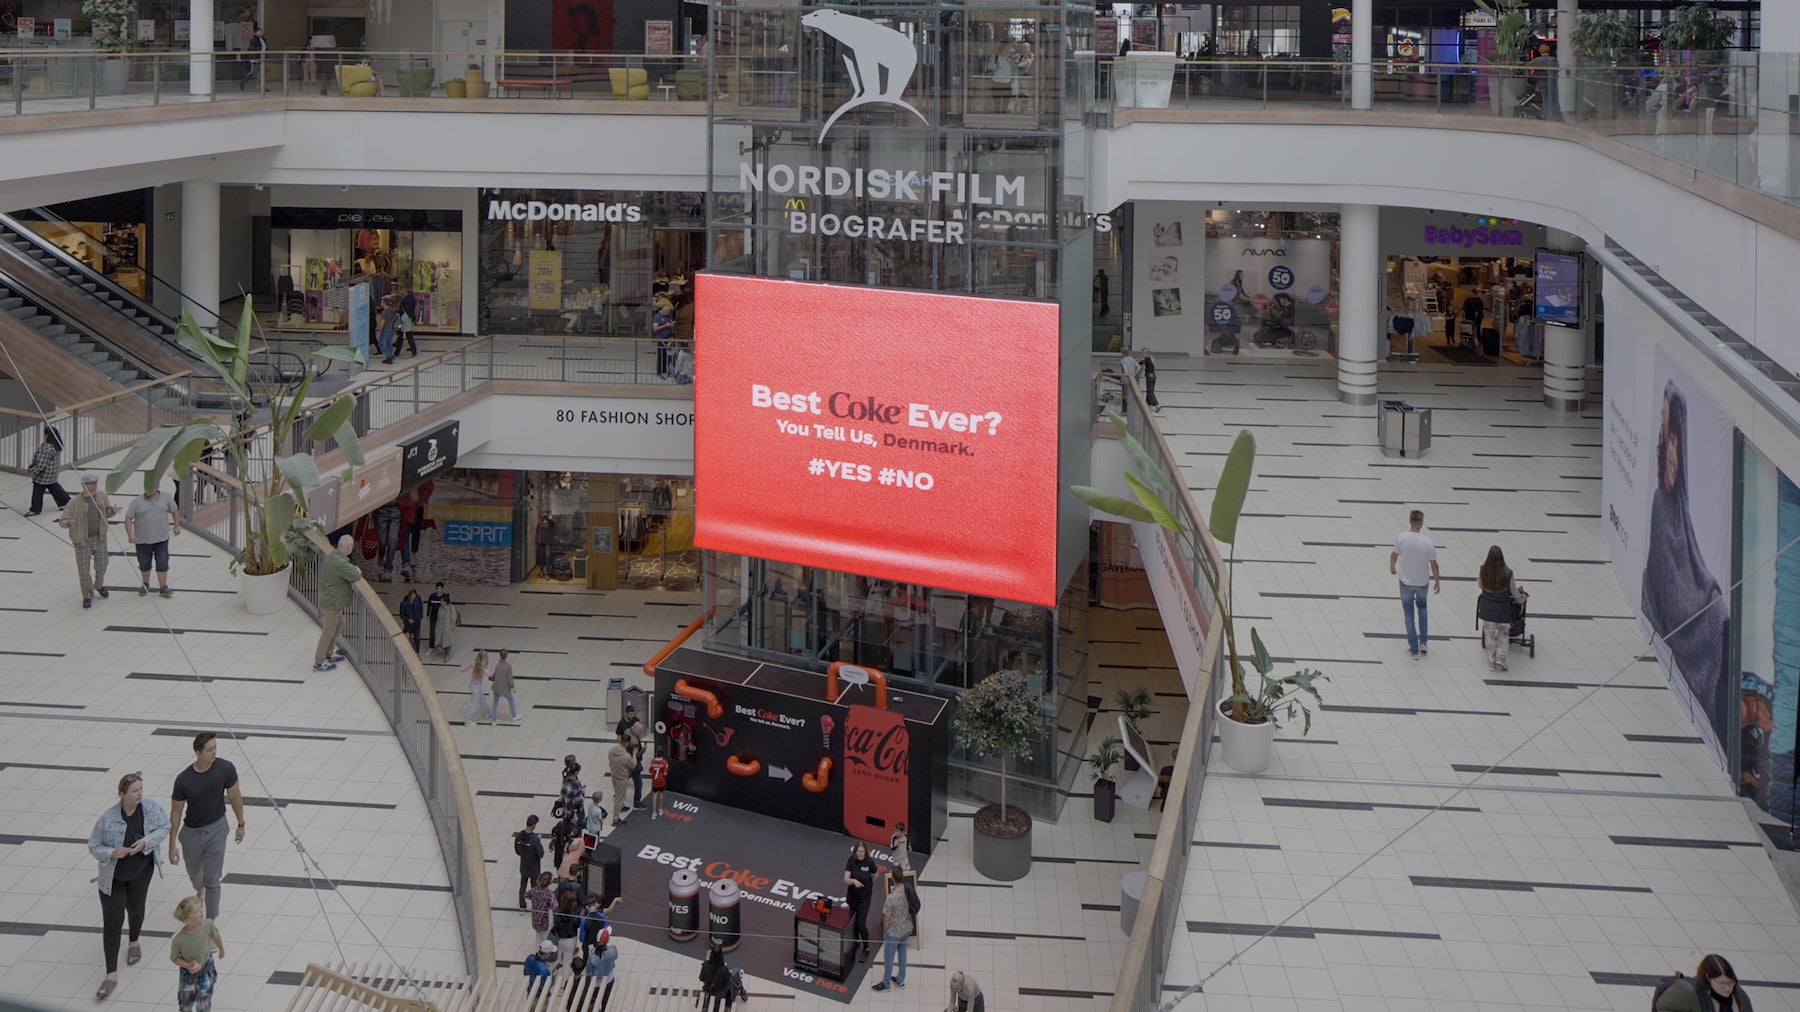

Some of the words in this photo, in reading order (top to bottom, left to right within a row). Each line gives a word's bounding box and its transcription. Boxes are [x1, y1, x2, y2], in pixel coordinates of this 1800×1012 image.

[740, 163, 919, 200] NORDISK
[931, 171, 1025, 206] FILM
[338, 213, 394, 223] piees
[488, 200, 641, 222] McDonald's
[790, 211, 965, 244] BIOGRAFER
[1424, 225, 1523, 248] BabySam
[1242, 248, 1288, 257] nuna
[1272, 271, 1290, 285] 50
[1213, 308, 1231, 321] 50
[556, 409, 575, 423] 80
[581, 410, 649, 424] FASHION
[752, 384, 822, 415] Best
[828, 391, 902, 425] Coke
[908, 403, 1003, 436] Ever?
[776, 419, 810, 436] You
[813, 424, 846, 441] Tell
[850, 429, 878, 448] Us,
[883, 433, 975, 457] Denmark.
[808, 458, 873, 483] #YES
[878, 467, 934, 490] #NO
[448, 524, 508, 543] ESPRIT
[735, 704, 756, 717] Best
[780, 714, 806, 728] Ever?
[654, 768, 660, 780] 7
[852, 768, 872, 777] ZERO
[672, 800, 699, 814] Win
[637, 844, 703, 872] Best
[705, 862, 771, 890] Coke
[739, 890, 797, 912] Denmark.
[784, 967, 814, 983] Vote
[816, 978, 848, 992] here
